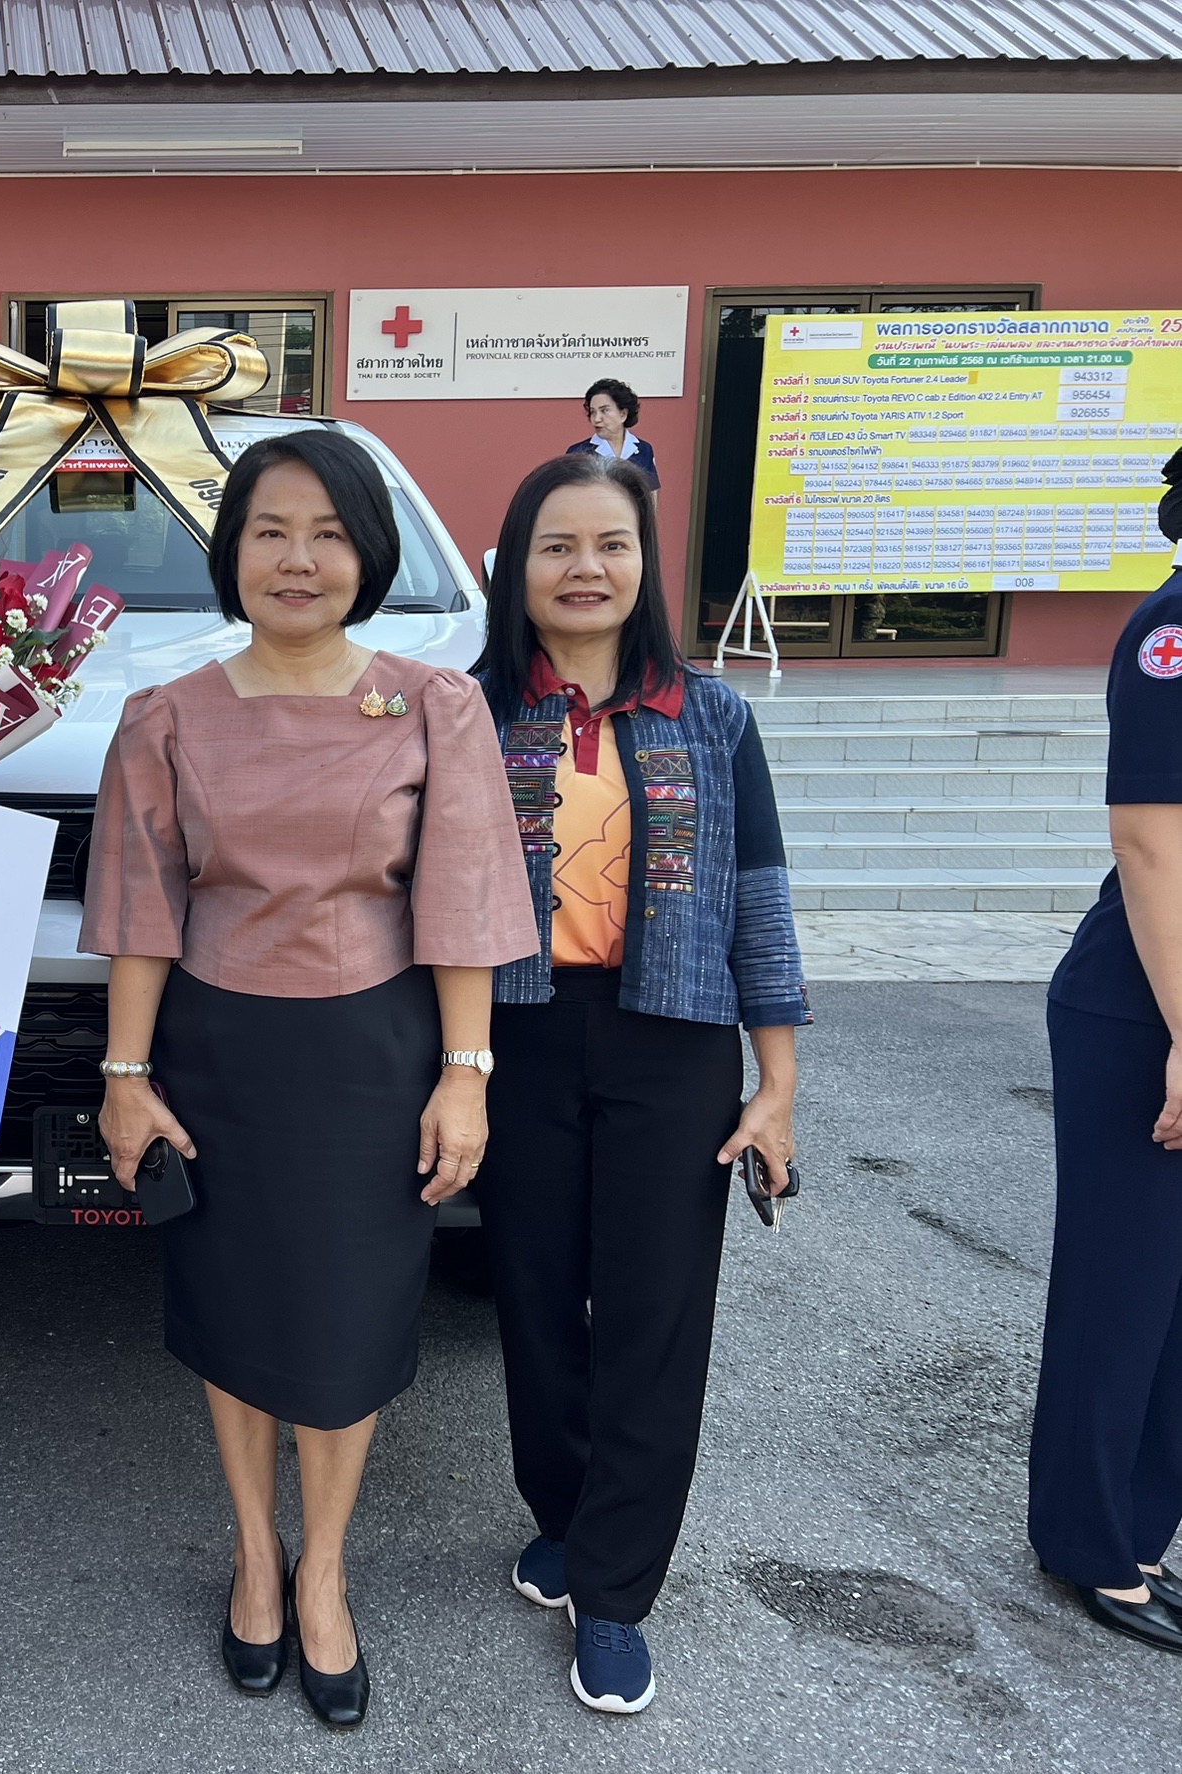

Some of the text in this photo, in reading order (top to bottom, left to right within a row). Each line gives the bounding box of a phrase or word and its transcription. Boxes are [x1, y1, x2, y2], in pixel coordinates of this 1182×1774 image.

[876, 316, 1109, 337] ผลการออกรางวัลสลากกาชาด
[466, 333, 649, 349] เหล่ากาชาดจังหวัดกำแพงเพชร
[514, 352, 529, 360] RED
[656, 350, 676, 358] PHET
[876, 354, 896, 366] วันที่
[898, 357, 911, 366] 22
[914, 354, 958, 368] กุมภาพันธ์
[962, 356, 984, 365] 2568
[1064, 356, 1084, 364] เวลา
[1086, 356, 1112, 364] 21.00
[356, 354, 443, 370] สภากาชาดไทย
[773, 373, 805, 386] รางวัลที่
[842, 376, 860, 384] SUV
[862, 376, 888, 386] Toyota
[891, 376, 924, 384] Fortuner
[926, 376, 938, 384] 2.4
[940, 375, 967, 383] Leader
[1074, 372, 1113, 382] 943312
[772, 391, 804, 404] รางวัลที่
[863, 394, 889, 404] Toyota
[892, 394, 916, 402] REVO
[917, 394, 924, 402] C
[925, 394, 940, 402] cab
[948, 393, 976, 401] Edition
[978, 392, 994, 400] 4X2
[994, 392, 1008, 400] 2.4
[1010, 392, 1029, 402] Entry
[1031, 392, 1042, 400] AT
[1072, 390, 1110, 400] 956454
[770, 409, 802, 422] รางวัลที่
[851, 412, 878, 422] Toyota
[879, 412, 905, 420] YARIS
[906, 412, 926, 420] ATIV
[942, 411, 964, 421] Sport
[1070, 408, 1110, 418] 926855
[769, 429, 798, 441] รางวัลที่
[870, 432, 893, 440] Smart
[768, 445, 798, 456] รางวัลที่
[800, 448, 804, 456] 5
[765, 492, 795, 504] รางวัลที่
[796, 496, 801, 504] 6
[1015, 578, 1034, 587] 008
[70, 1209, 147, 1226] TOYOT
